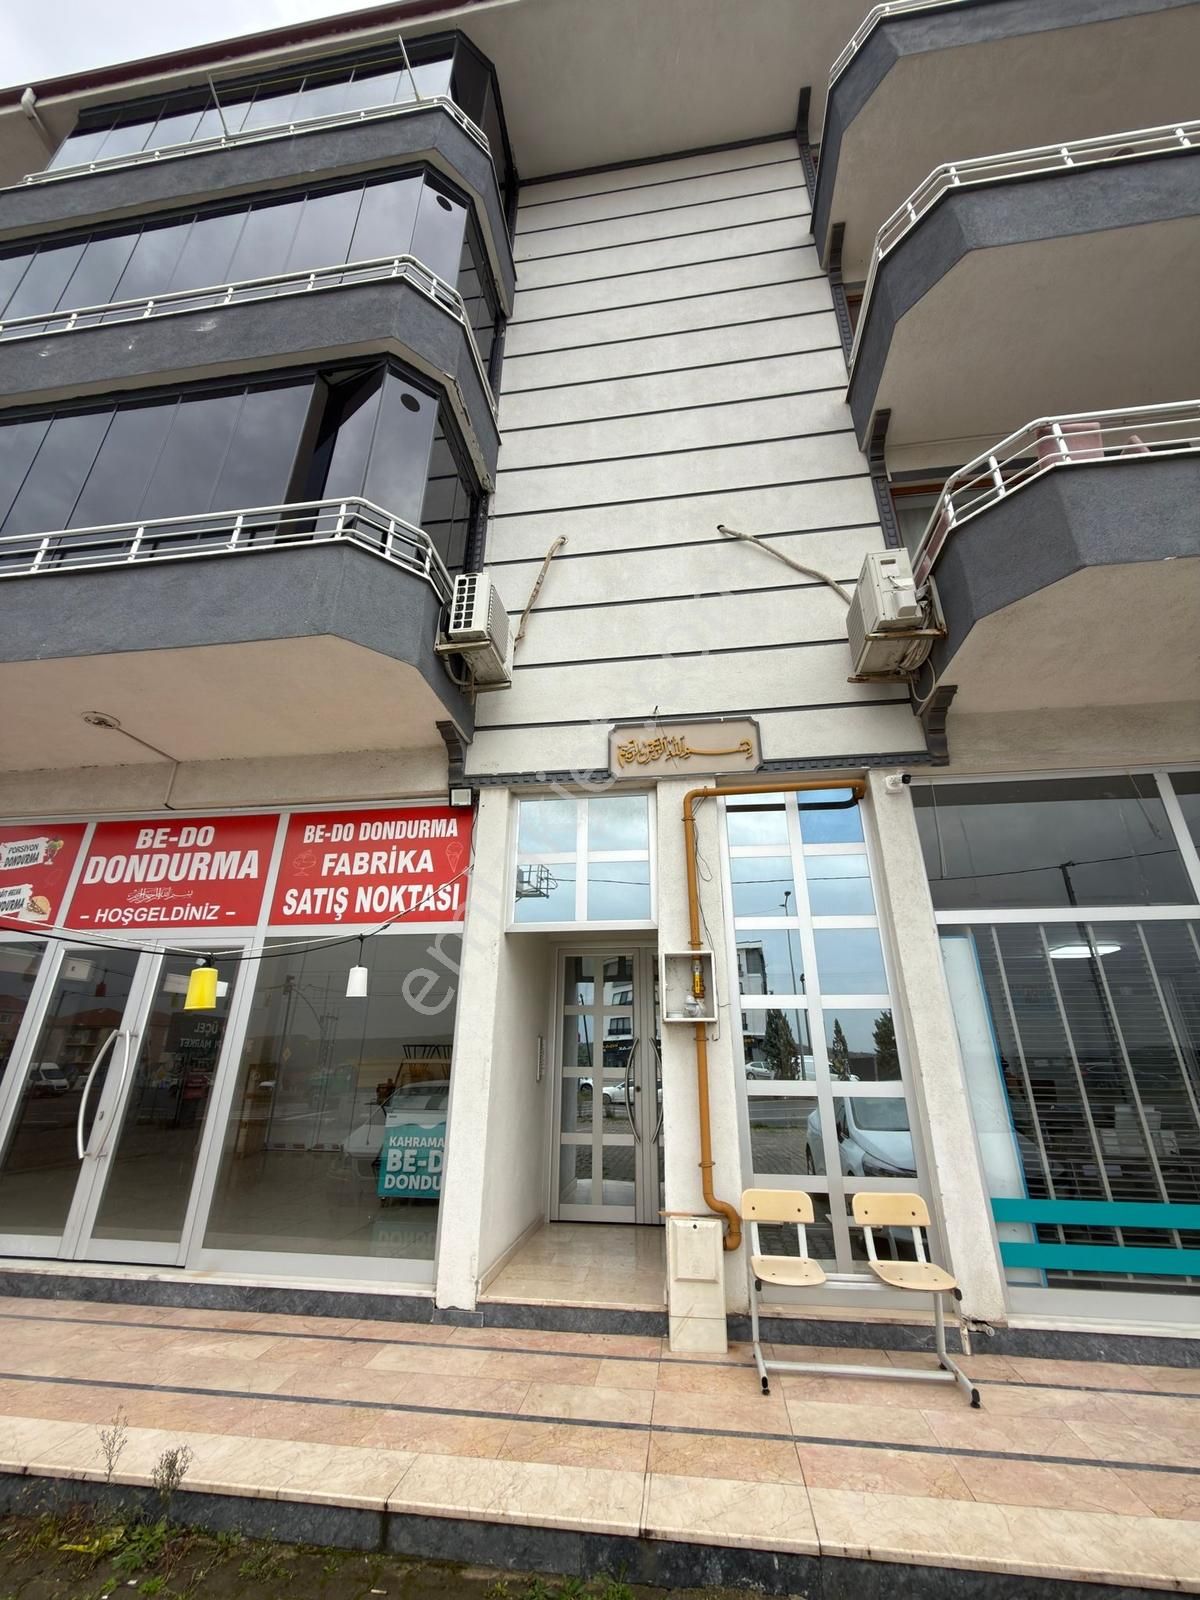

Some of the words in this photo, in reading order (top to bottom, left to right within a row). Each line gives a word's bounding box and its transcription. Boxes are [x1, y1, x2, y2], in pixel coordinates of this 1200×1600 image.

[135, 825, 215, 849] BE-DO
[303, 822, 355, 844] BE-DO
[359, 818, 458, 841] DONDURMA
[82, 850, 259, 885] DONDURMA
[321, 845, 434, 877] FABRİKA
[94, 903, 221, 926] HOŞGELDİNİZ
[282, 886, 349, 921] SATIŞ
[355, 883, 460, 913] NOKTASI
